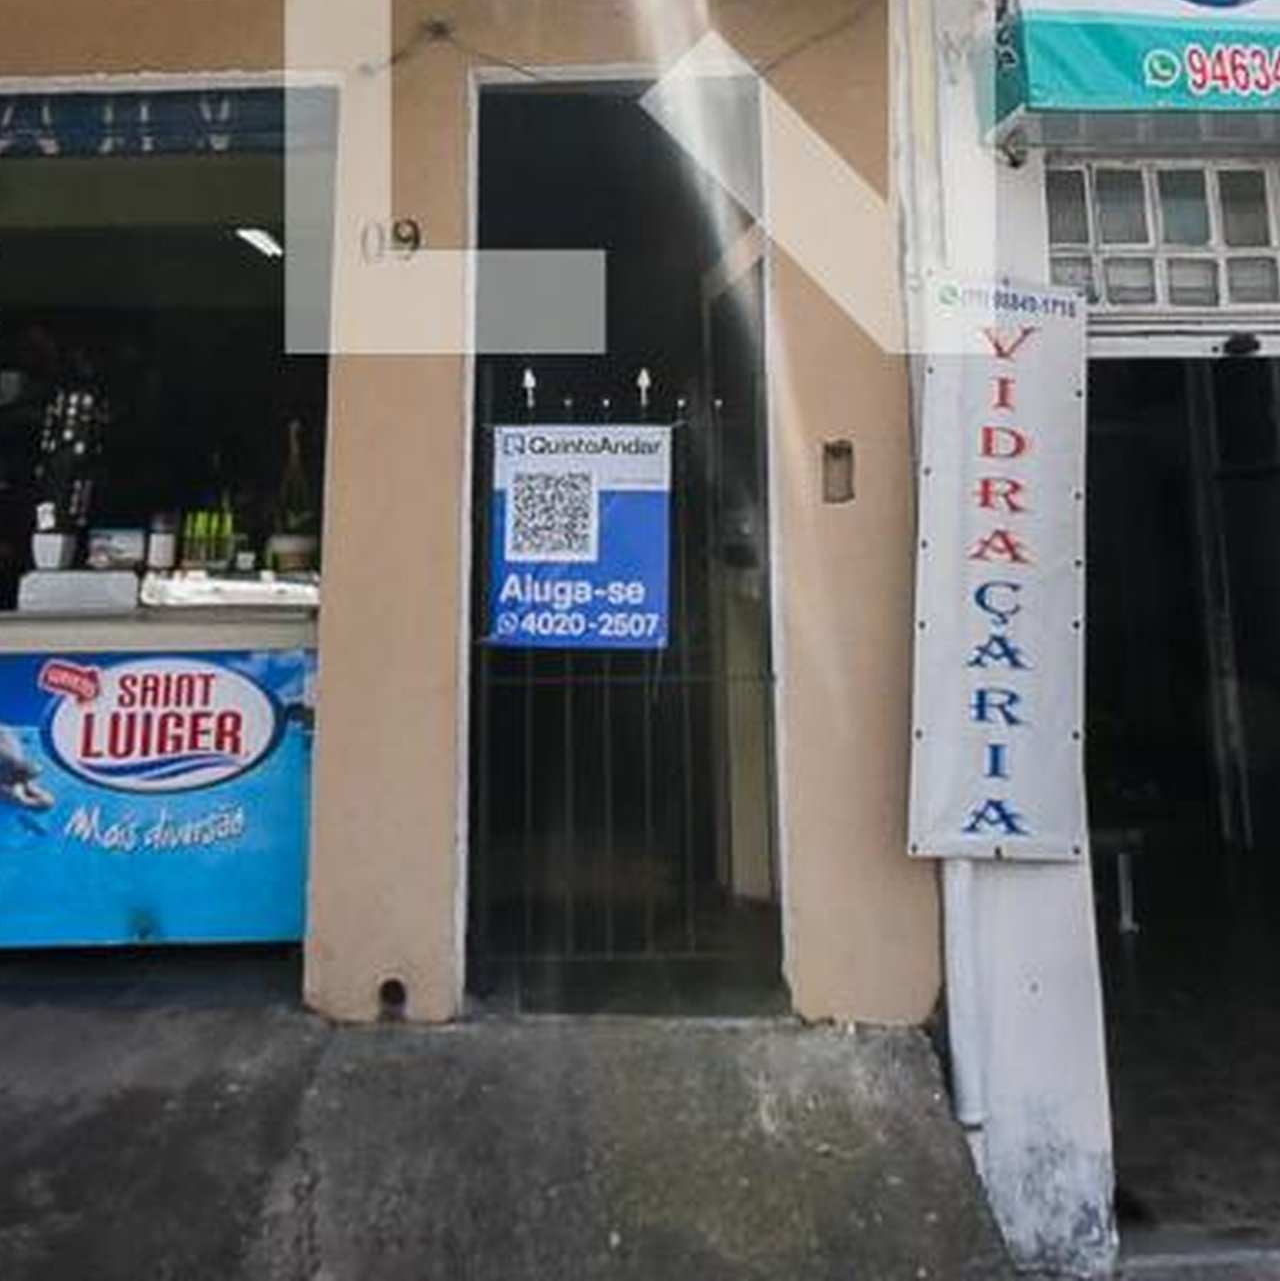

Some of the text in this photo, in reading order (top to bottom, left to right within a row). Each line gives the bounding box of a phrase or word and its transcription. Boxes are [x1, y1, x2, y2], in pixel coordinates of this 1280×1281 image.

[528, 435, 661, 455] QuintoAndar
[499, 573, 645, 609] Aluga-se
[963, 325, 1038, 836] VIDRAÇARIA
[521, 612, 659, 637] 4020-2507
[119, 672, 217, 707] SAINT
[80, 710, 244, 759] LUIGER
